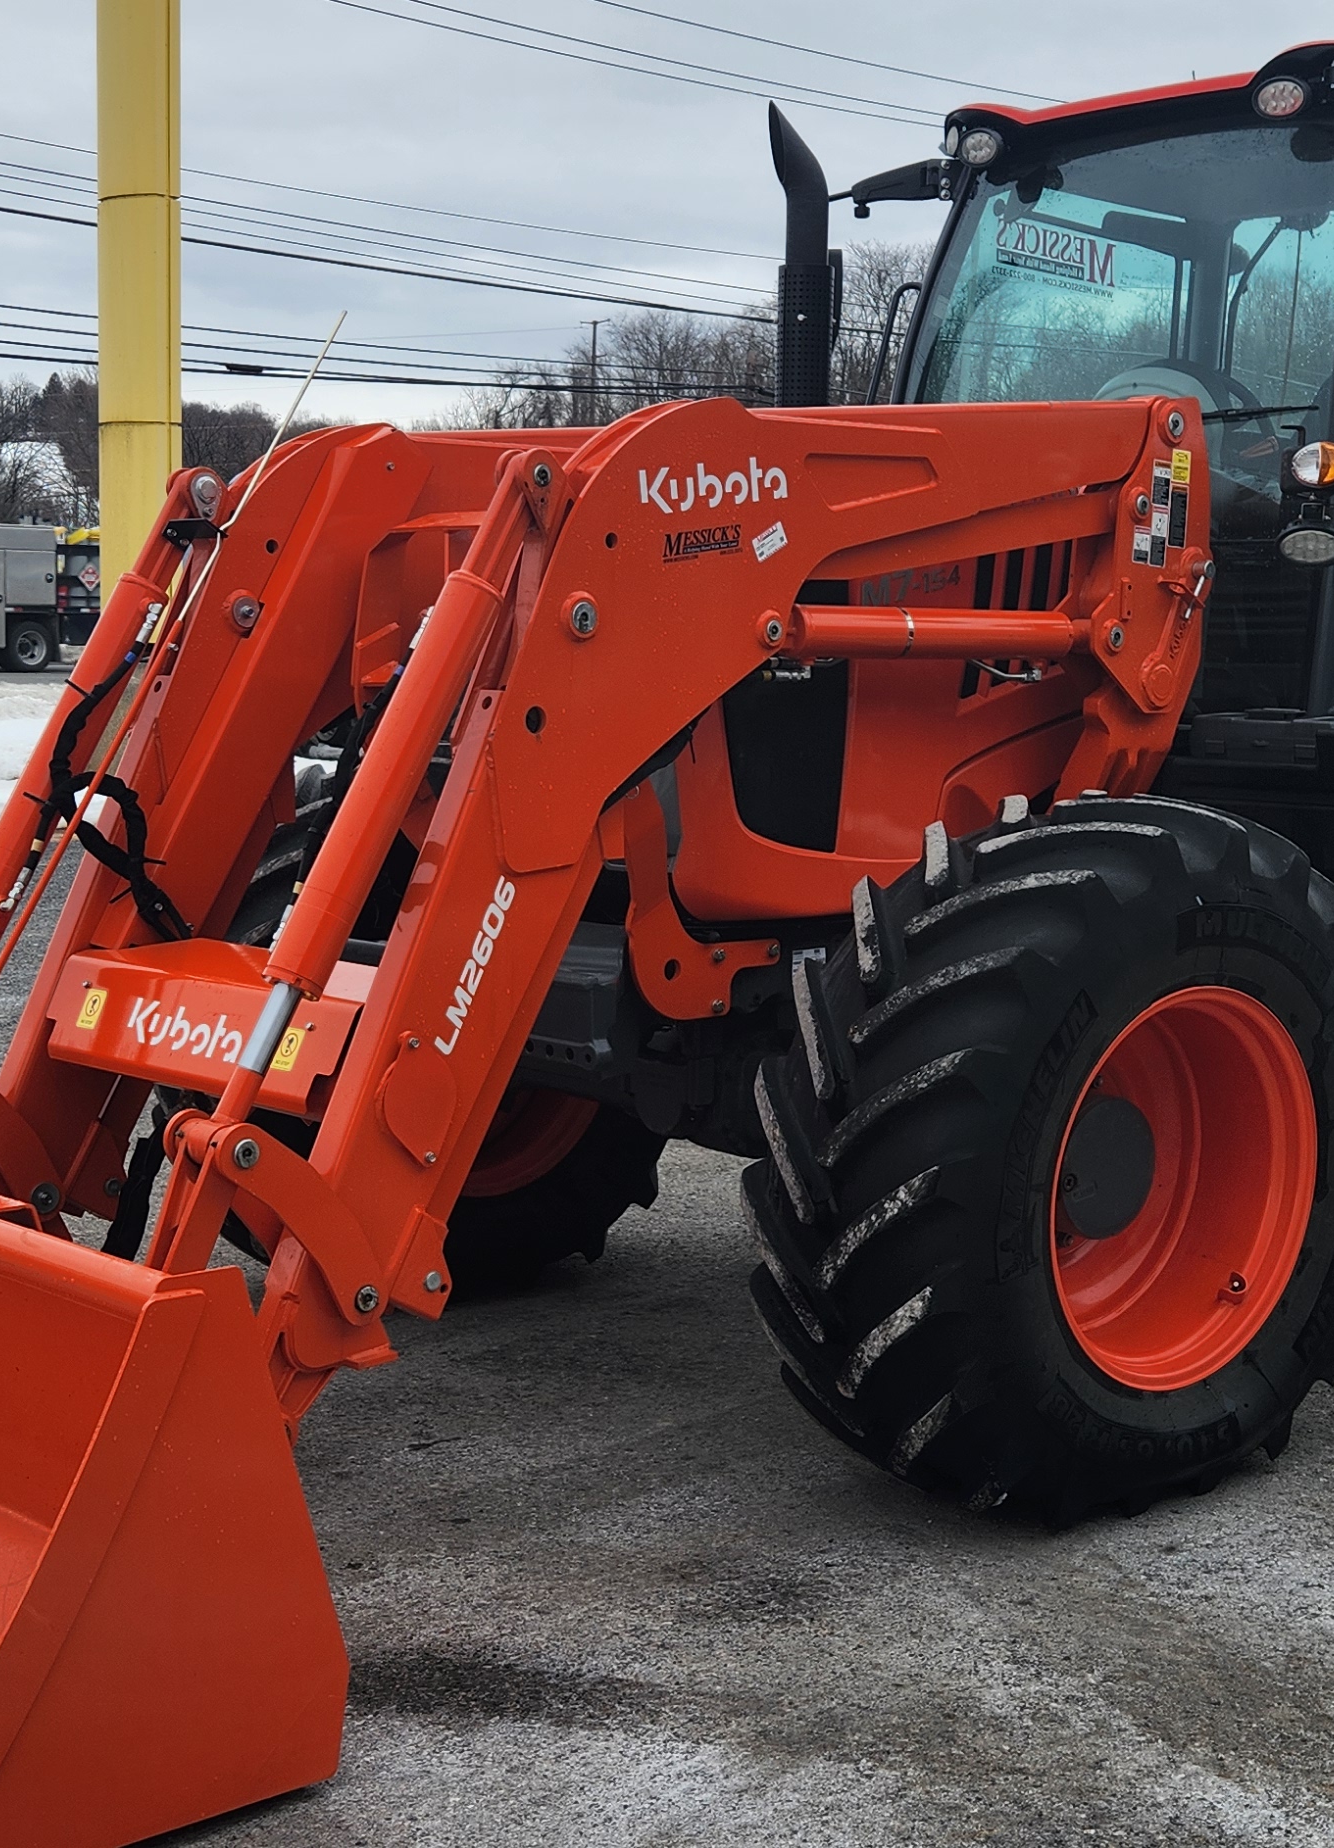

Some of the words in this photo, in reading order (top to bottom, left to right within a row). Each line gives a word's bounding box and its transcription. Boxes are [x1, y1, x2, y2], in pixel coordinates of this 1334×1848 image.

[639, 456, 788, 514] Kubota
[662, 524, 741, 558] MESSICK'S
[862, 565, 961, 606] M7-154
[434, 875, 516, 1056] LM2606
[127, 997, 243, 1063] Kubota
